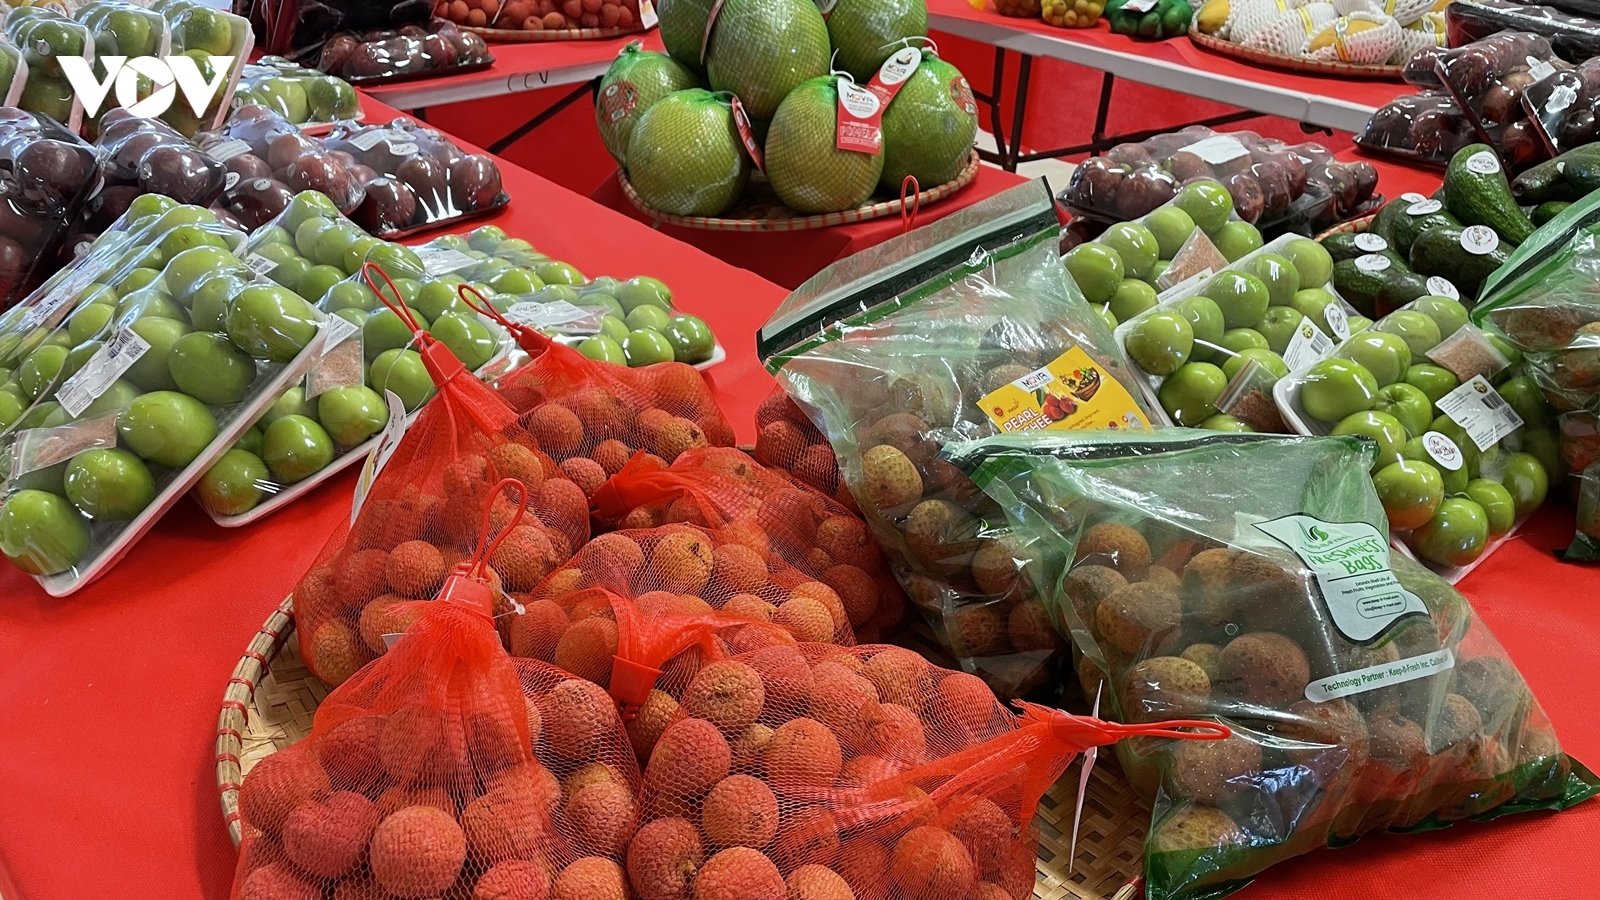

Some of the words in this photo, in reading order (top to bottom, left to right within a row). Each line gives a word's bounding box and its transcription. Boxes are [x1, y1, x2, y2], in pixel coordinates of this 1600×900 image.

[846, 92, 874, 103] MOVA
[1021, 372, 1048, 388] MOVA
[1003, 407, 1040, 433] PEARL
[1339, 555, 1383, 574] Bags
[1322, 676, 1361, 692] Technology
[1361, 671, 1385, 684] Partner
